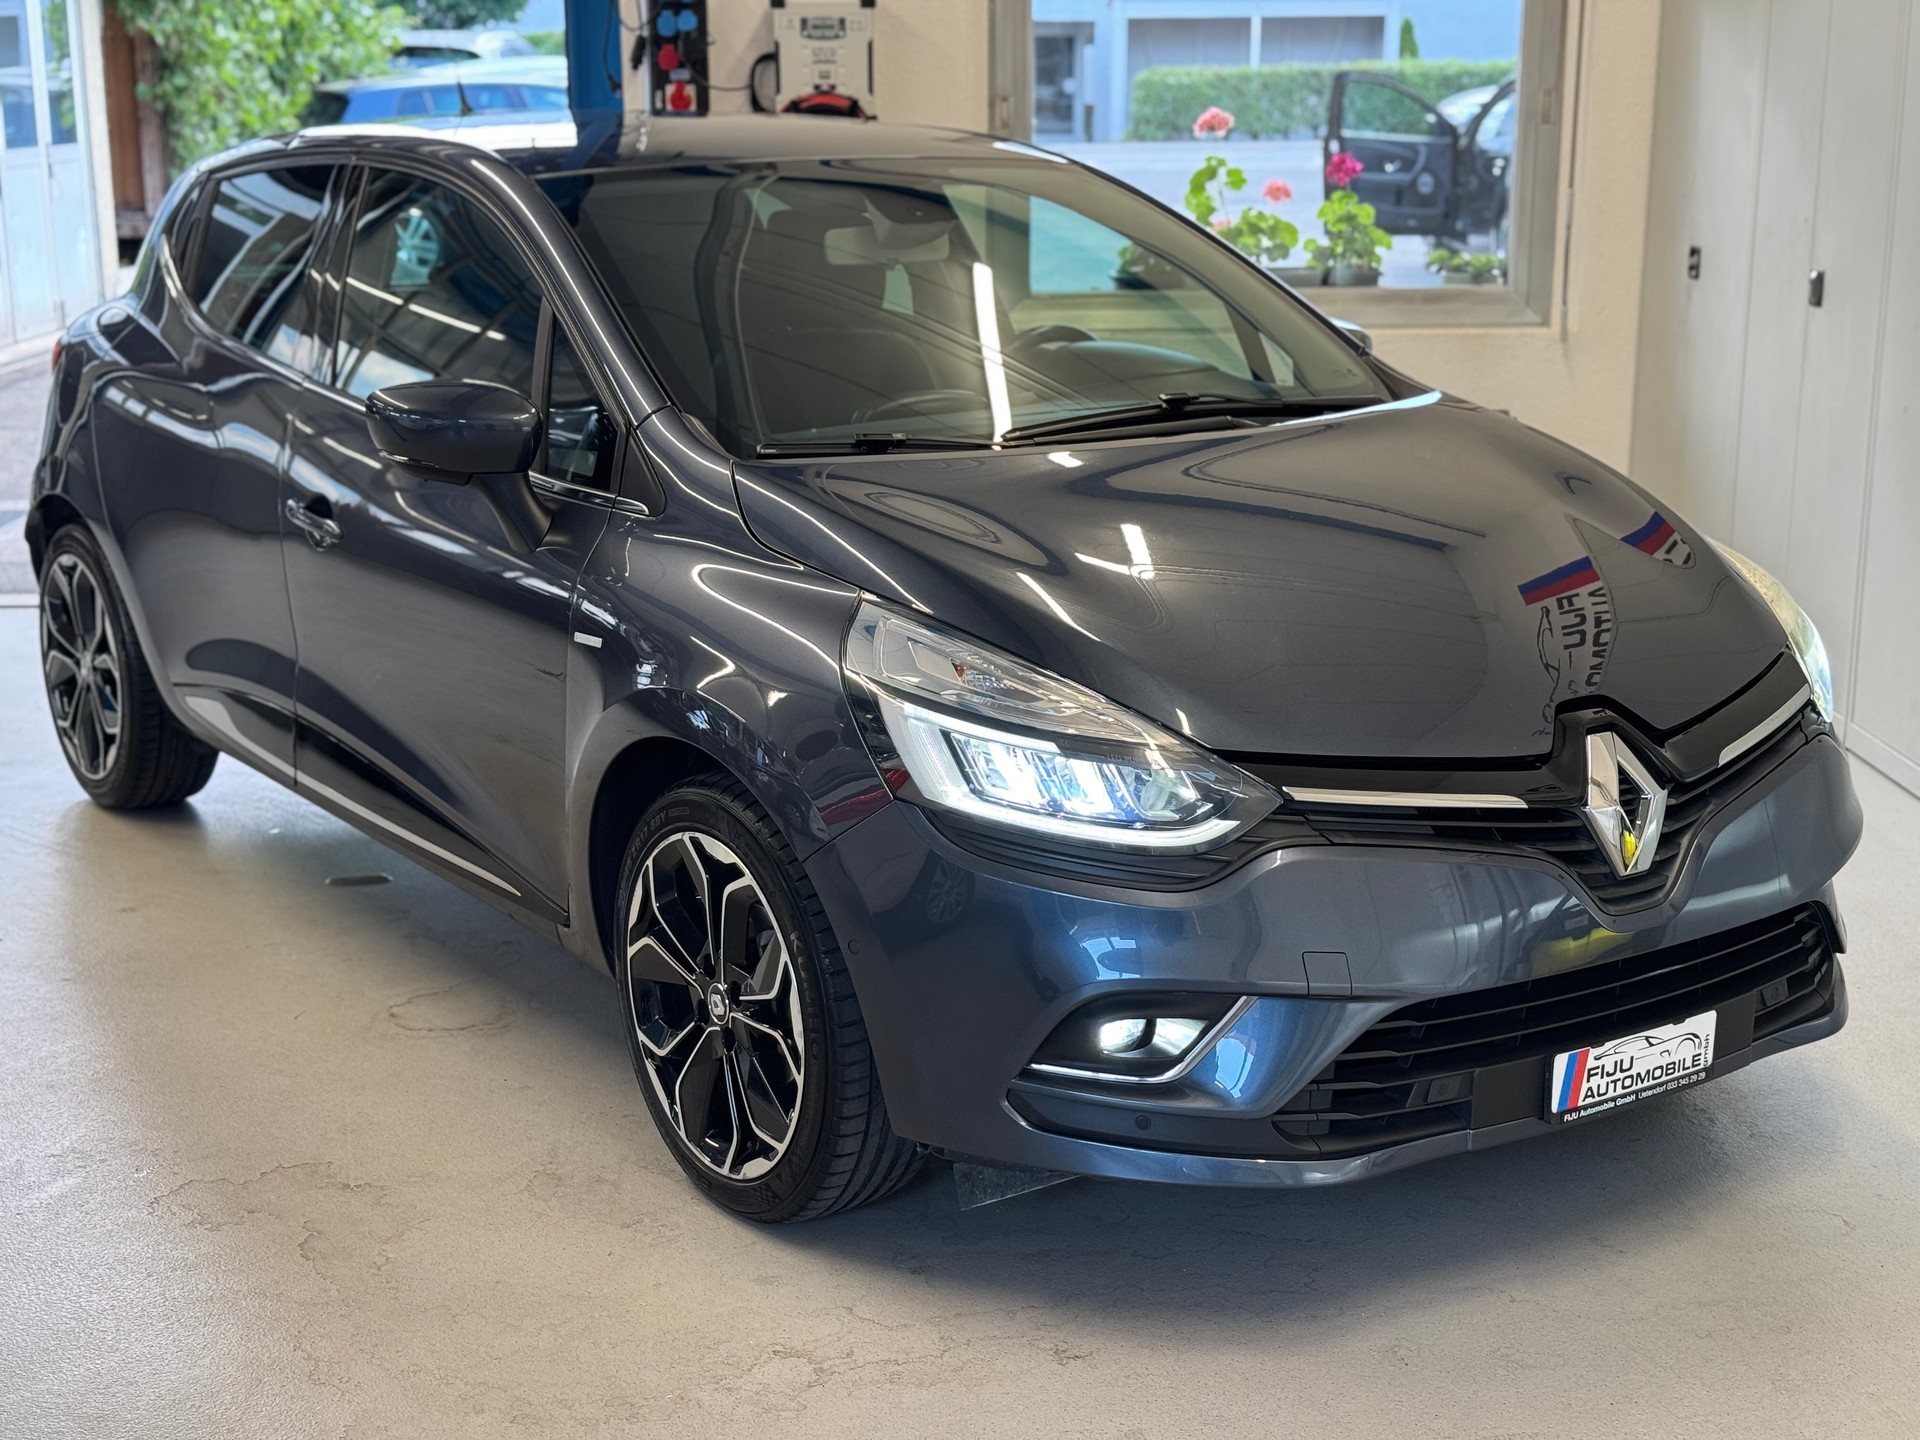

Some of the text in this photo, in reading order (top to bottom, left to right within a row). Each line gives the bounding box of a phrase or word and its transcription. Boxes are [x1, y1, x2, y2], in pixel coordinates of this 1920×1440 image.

[1582, 1053, 1702, 1102] AUTOMOBILE
[1587, 1056, 1634, 1083] FIJU
[1564, 1072, 1706, 1122] FIJU Automobile GmbH Uetendorf 033 345 29 29
